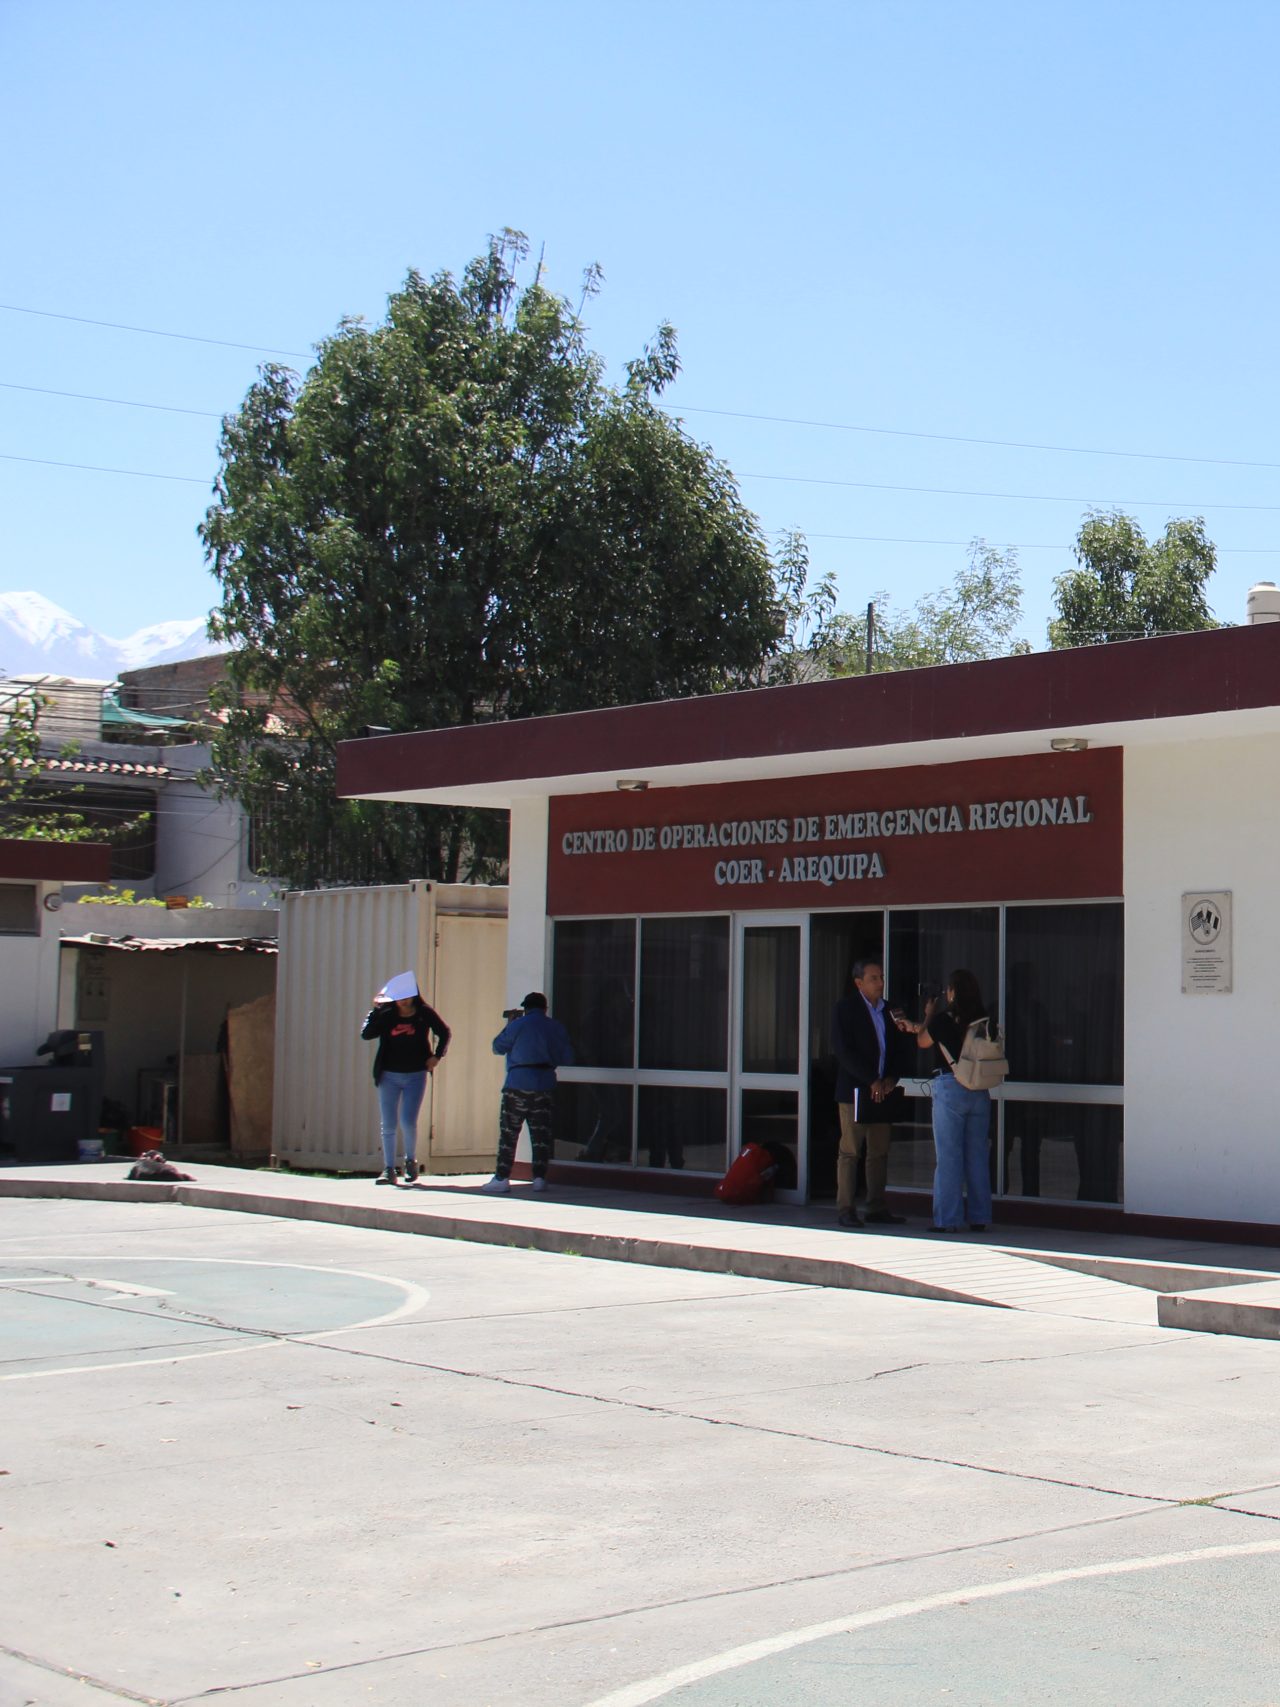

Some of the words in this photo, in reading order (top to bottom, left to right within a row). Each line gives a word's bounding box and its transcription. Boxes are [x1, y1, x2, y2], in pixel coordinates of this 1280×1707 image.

[562, 828, 628, 856] CENTRO
[632, 826, 656, 851] DE
[660, 817, 789, 850] OPERACIONES
[792, 816, 820, 843] DE
[824, 805, 963, 841] EMERGENCIA
[968, 795, 1091, 831] REGIONAL
[714, 858, 764, 885] COER
[778, 852, 885, 887] AREQUIPA
